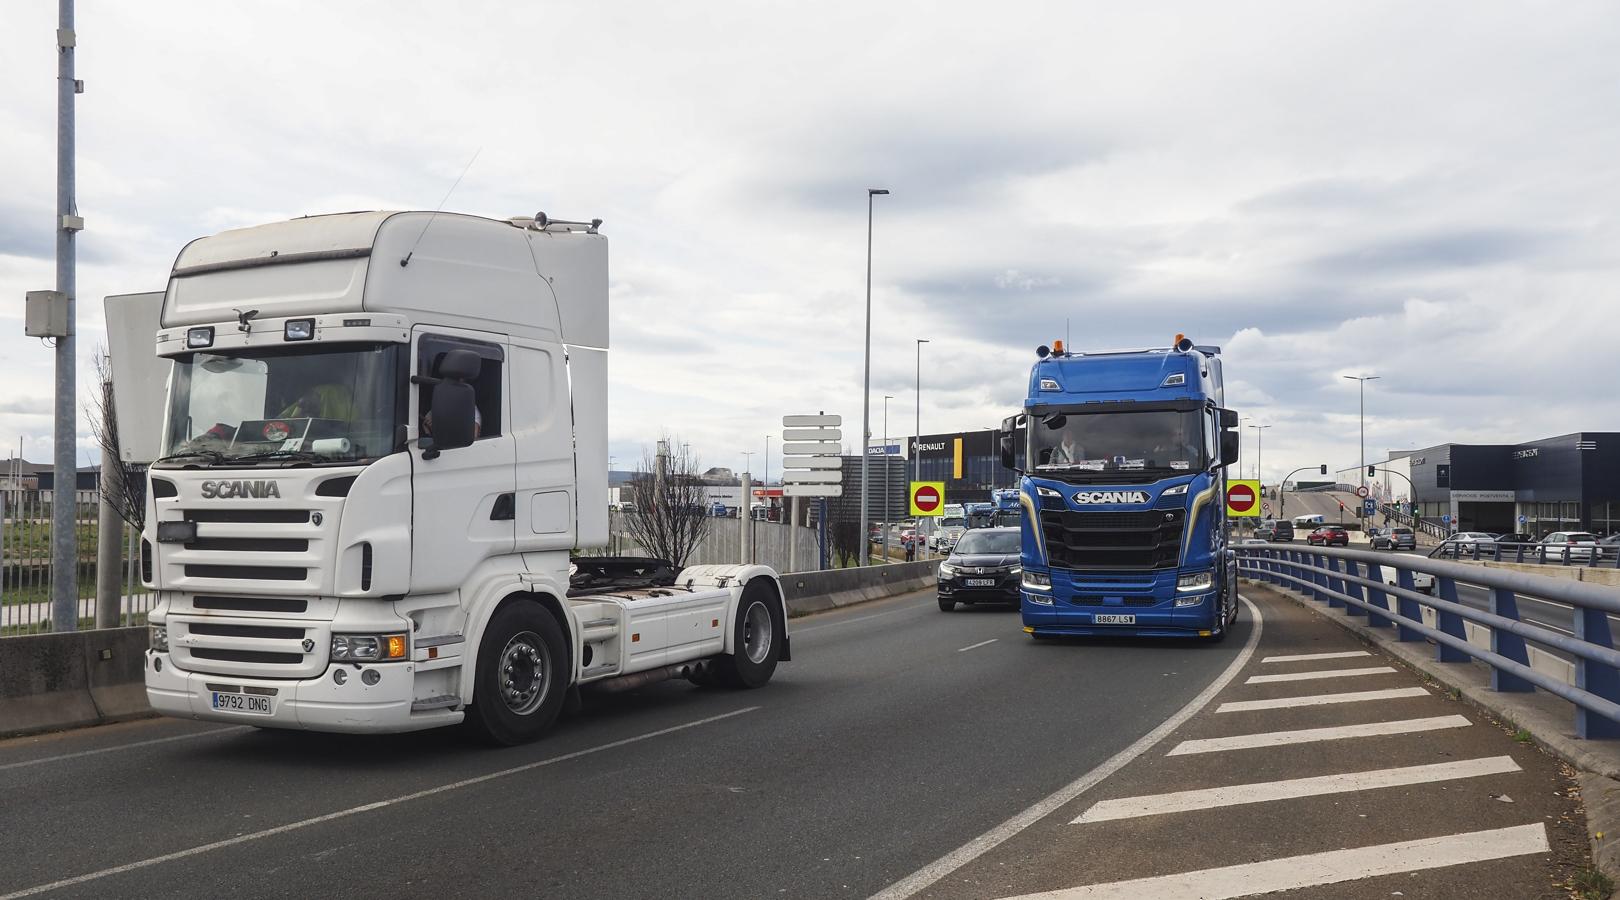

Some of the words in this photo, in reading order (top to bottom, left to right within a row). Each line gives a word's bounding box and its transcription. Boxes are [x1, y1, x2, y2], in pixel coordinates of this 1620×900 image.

[918, 442, 945, 451] RENAULT
[201, 480, 281, 499] SCANIA
[1076, 492, 1146, 504] SCANIA
[1097, 615, 1117, 623] 8867
[218, 694, 243, 709] 9792
[248, 697, 268, 711] DNG
